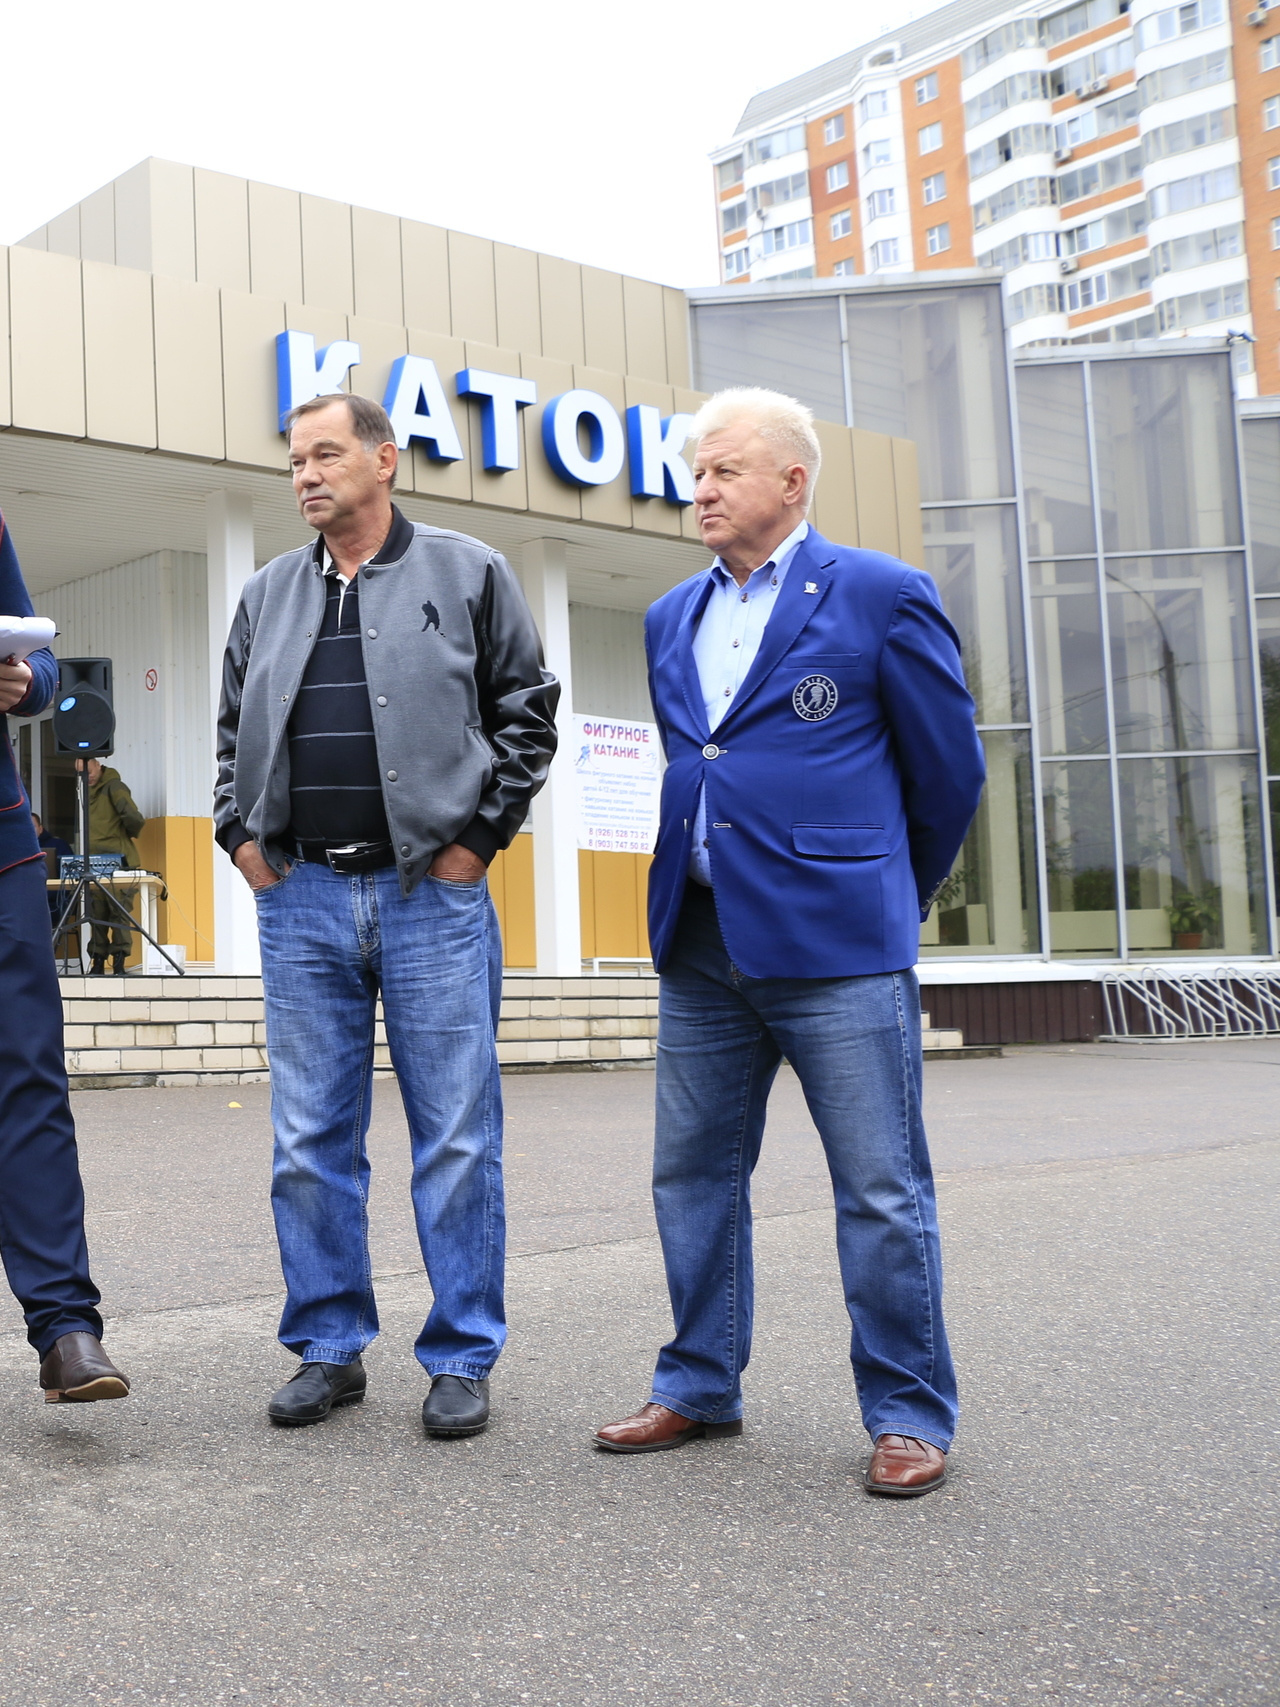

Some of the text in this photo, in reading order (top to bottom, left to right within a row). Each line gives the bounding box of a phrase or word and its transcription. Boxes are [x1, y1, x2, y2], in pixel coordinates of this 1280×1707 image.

[276, 329, 694, 506] КАТОК
[583, 722, 649, 742] ФИГУРНОЕ
[594, 744, 639, 759] КАТАНИЕ
[595, 828, 613, 838] (926)
[595, 839, 613, 849] (903)
[615, 841, 628, 849] 747
